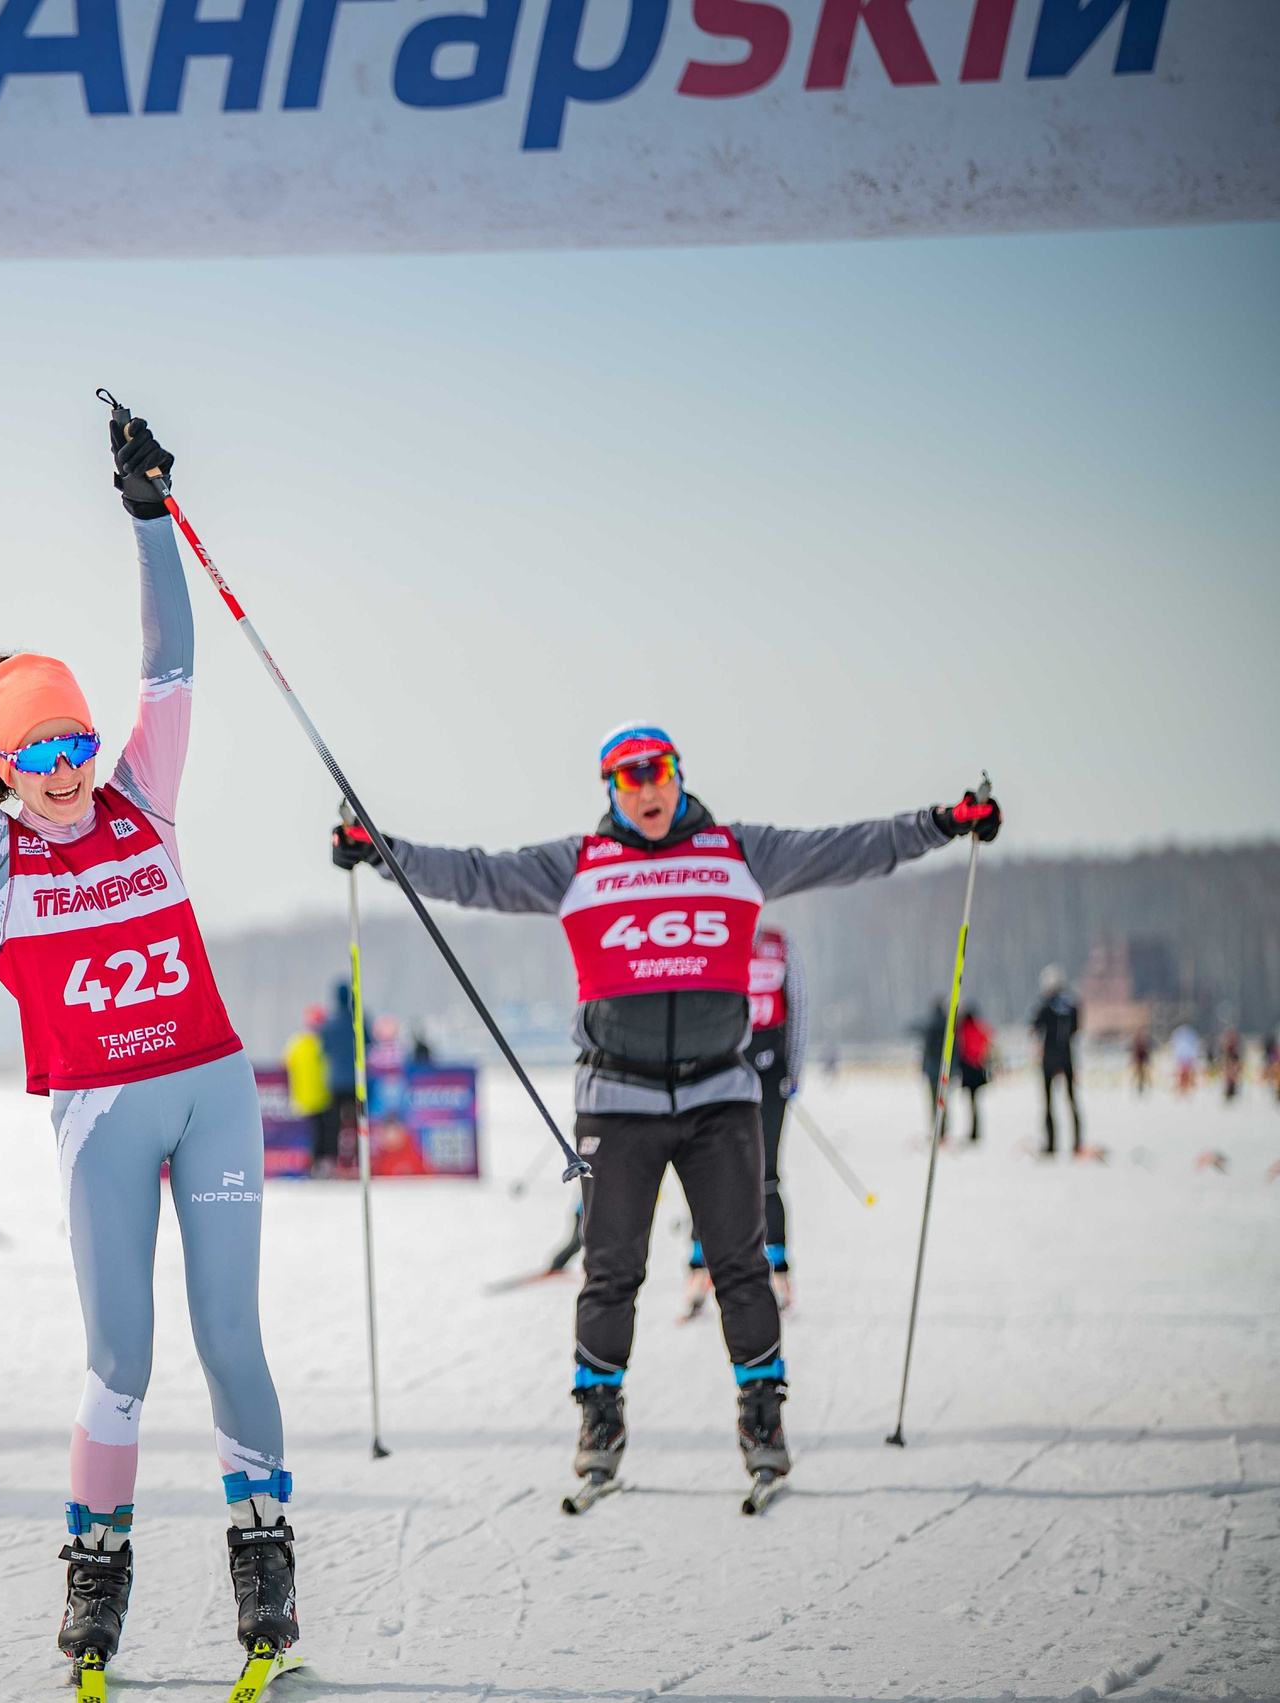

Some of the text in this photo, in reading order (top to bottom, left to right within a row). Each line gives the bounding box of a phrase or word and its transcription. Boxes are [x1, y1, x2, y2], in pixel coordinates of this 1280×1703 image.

[33, 864, 168, 917] ТЕМЕРСО
[600, 910, 730, 950] 465
[63, 936, 190, 1012] 423
[98, 1021, 177, 1048] ТЕМЕРСО
[107, 1035, 176, 1060] АНГАРА
[242, 1529, 285, 1540] SPINE
[70, 1551, 112, 1563] SPINE
